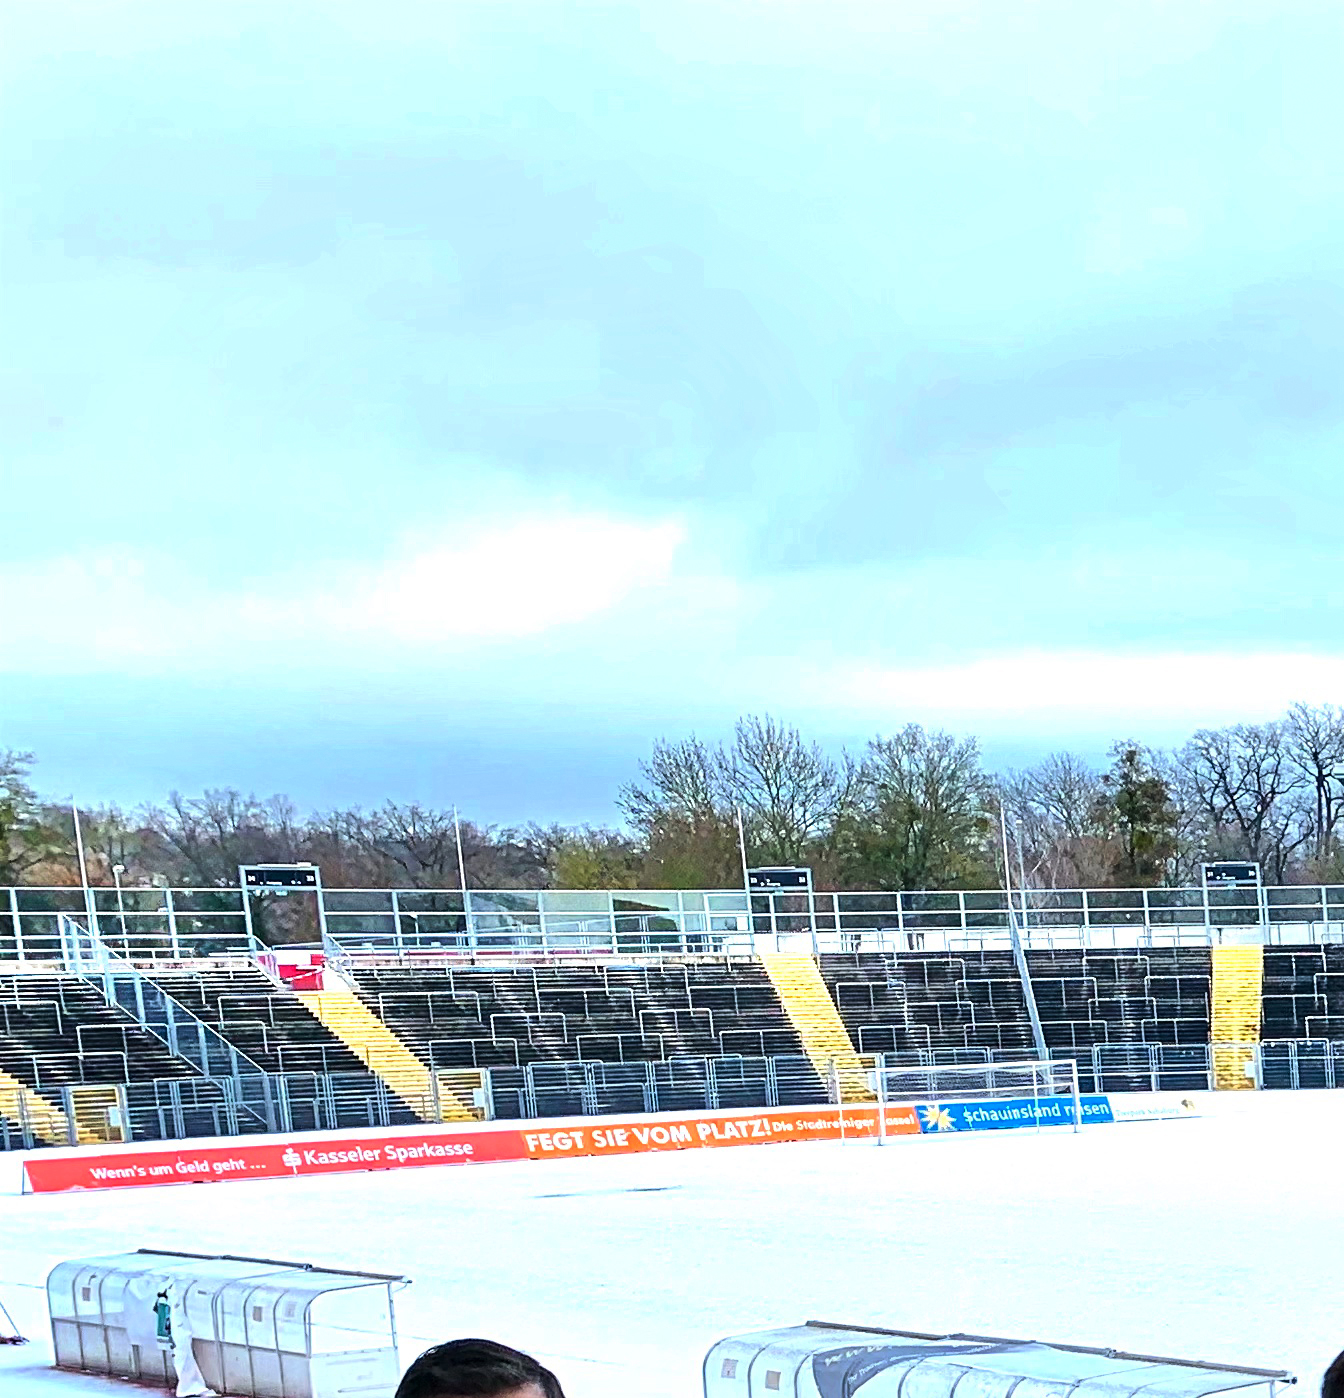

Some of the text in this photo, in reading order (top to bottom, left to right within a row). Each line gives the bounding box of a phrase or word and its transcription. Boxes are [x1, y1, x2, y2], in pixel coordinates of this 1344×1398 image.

[526, 1131, 584, 1152] FEGT
[592, 1128, 626, 1148] SIE
[631, 1125, 692, 1145] VOM
[696, 1118, 772, 1141] PLATZ!
[881, 1114, 915, 1126] assel
[304, 1141, 473, 1165] Kasseler Sparkasse
[90, 1165, 146, 1180] Wenn's
[149, 1165, 172, 1176] um
[177, 1160, 209, 1174] Geld
[213, 1159, 246, 1175] geht
